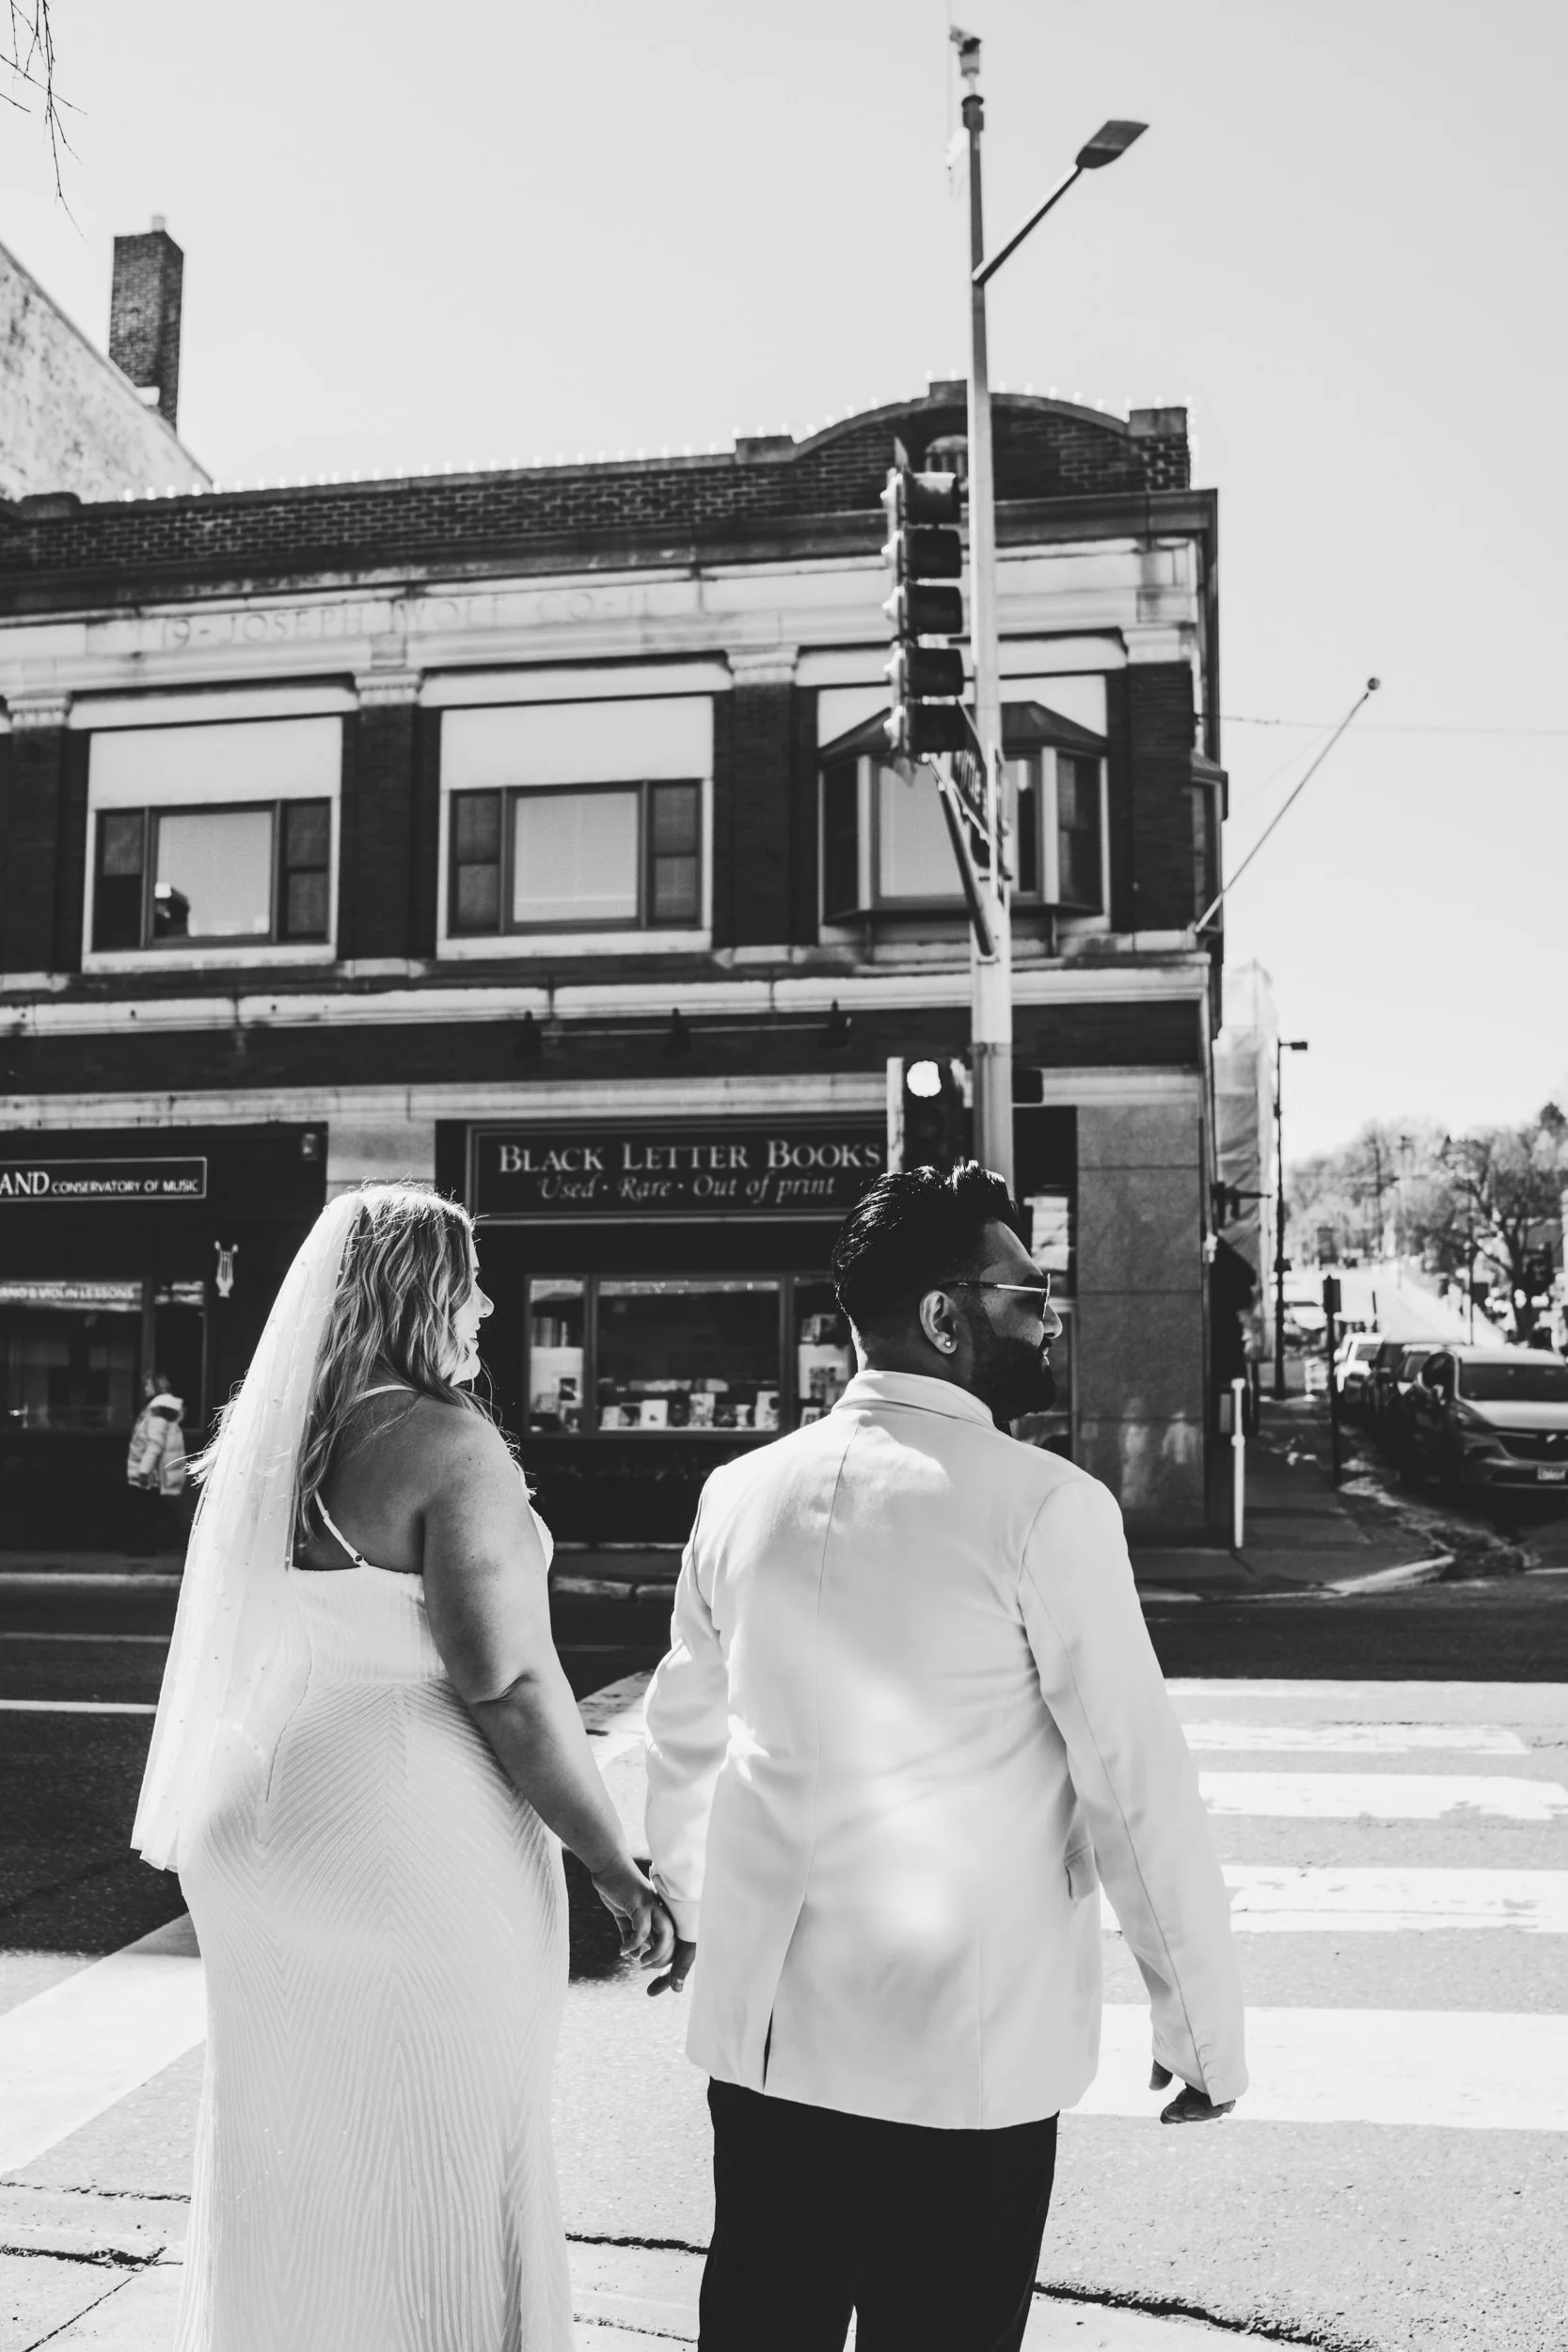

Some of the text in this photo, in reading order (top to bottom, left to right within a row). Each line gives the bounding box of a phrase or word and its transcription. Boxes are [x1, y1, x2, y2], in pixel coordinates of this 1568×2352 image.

[499, 1139, 881, 1172] BLACK LETTER BOOKS
[52, 1180, 140, 1194] CONSERVATORY
[144, 1180, 159, 1193] OF
[163, 1179, 198, 1193] MUSIC
[538, 1172, 835, 1203] Used Rare Out of print
[39, 1286, 79, 1299] VIOLIN
[80, 1285, 135, 1299] LESSONS
